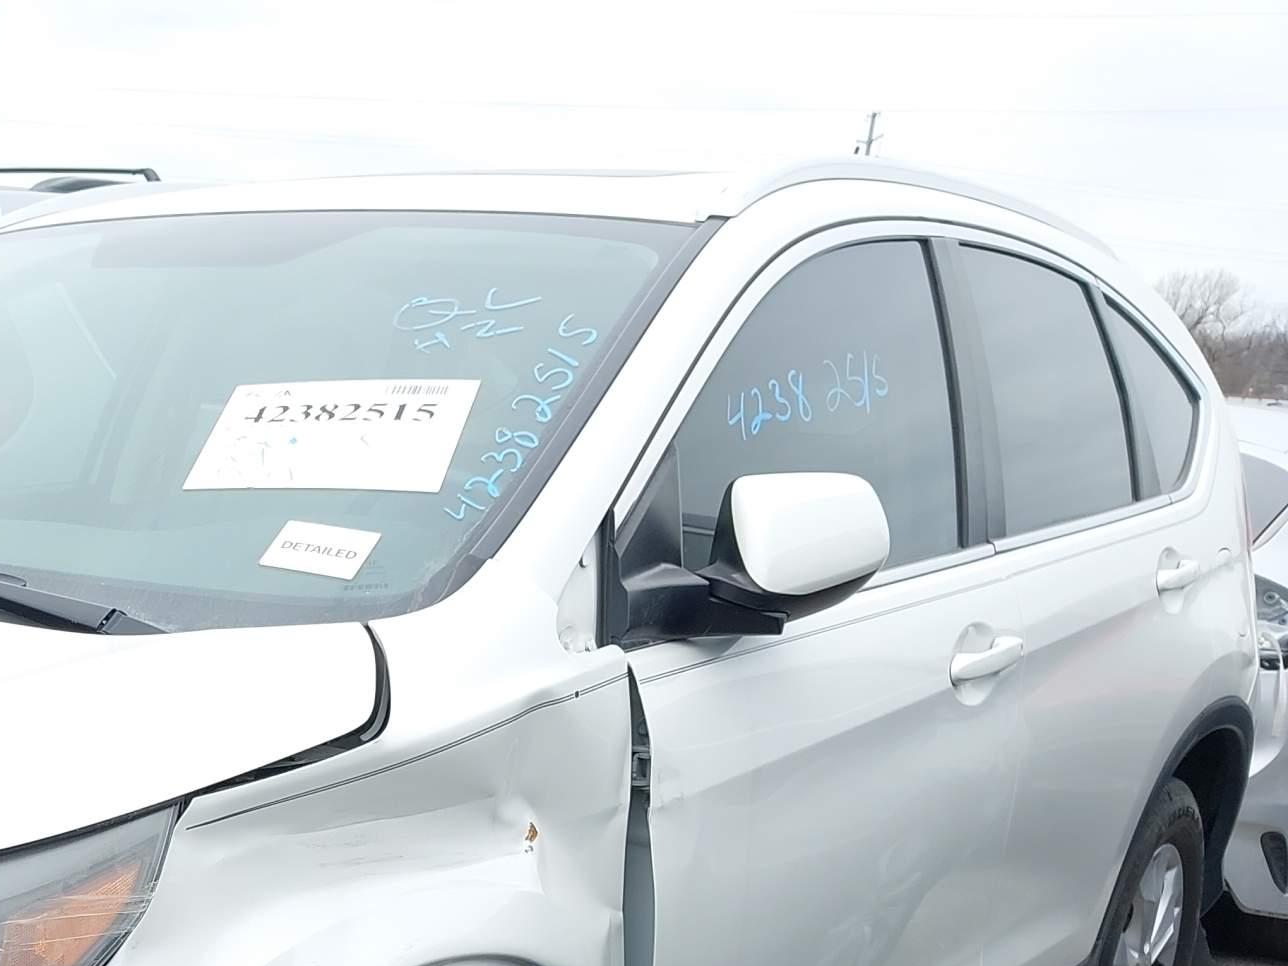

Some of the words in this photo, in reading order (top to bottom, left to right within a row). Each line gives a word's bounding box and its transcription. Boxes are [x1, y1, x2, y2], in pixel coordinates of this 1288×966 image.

[244, 403, 439, 423] 42382515
[727, 369, 812, 440] 4238
[280, 540, 358, 560] DETAILED
